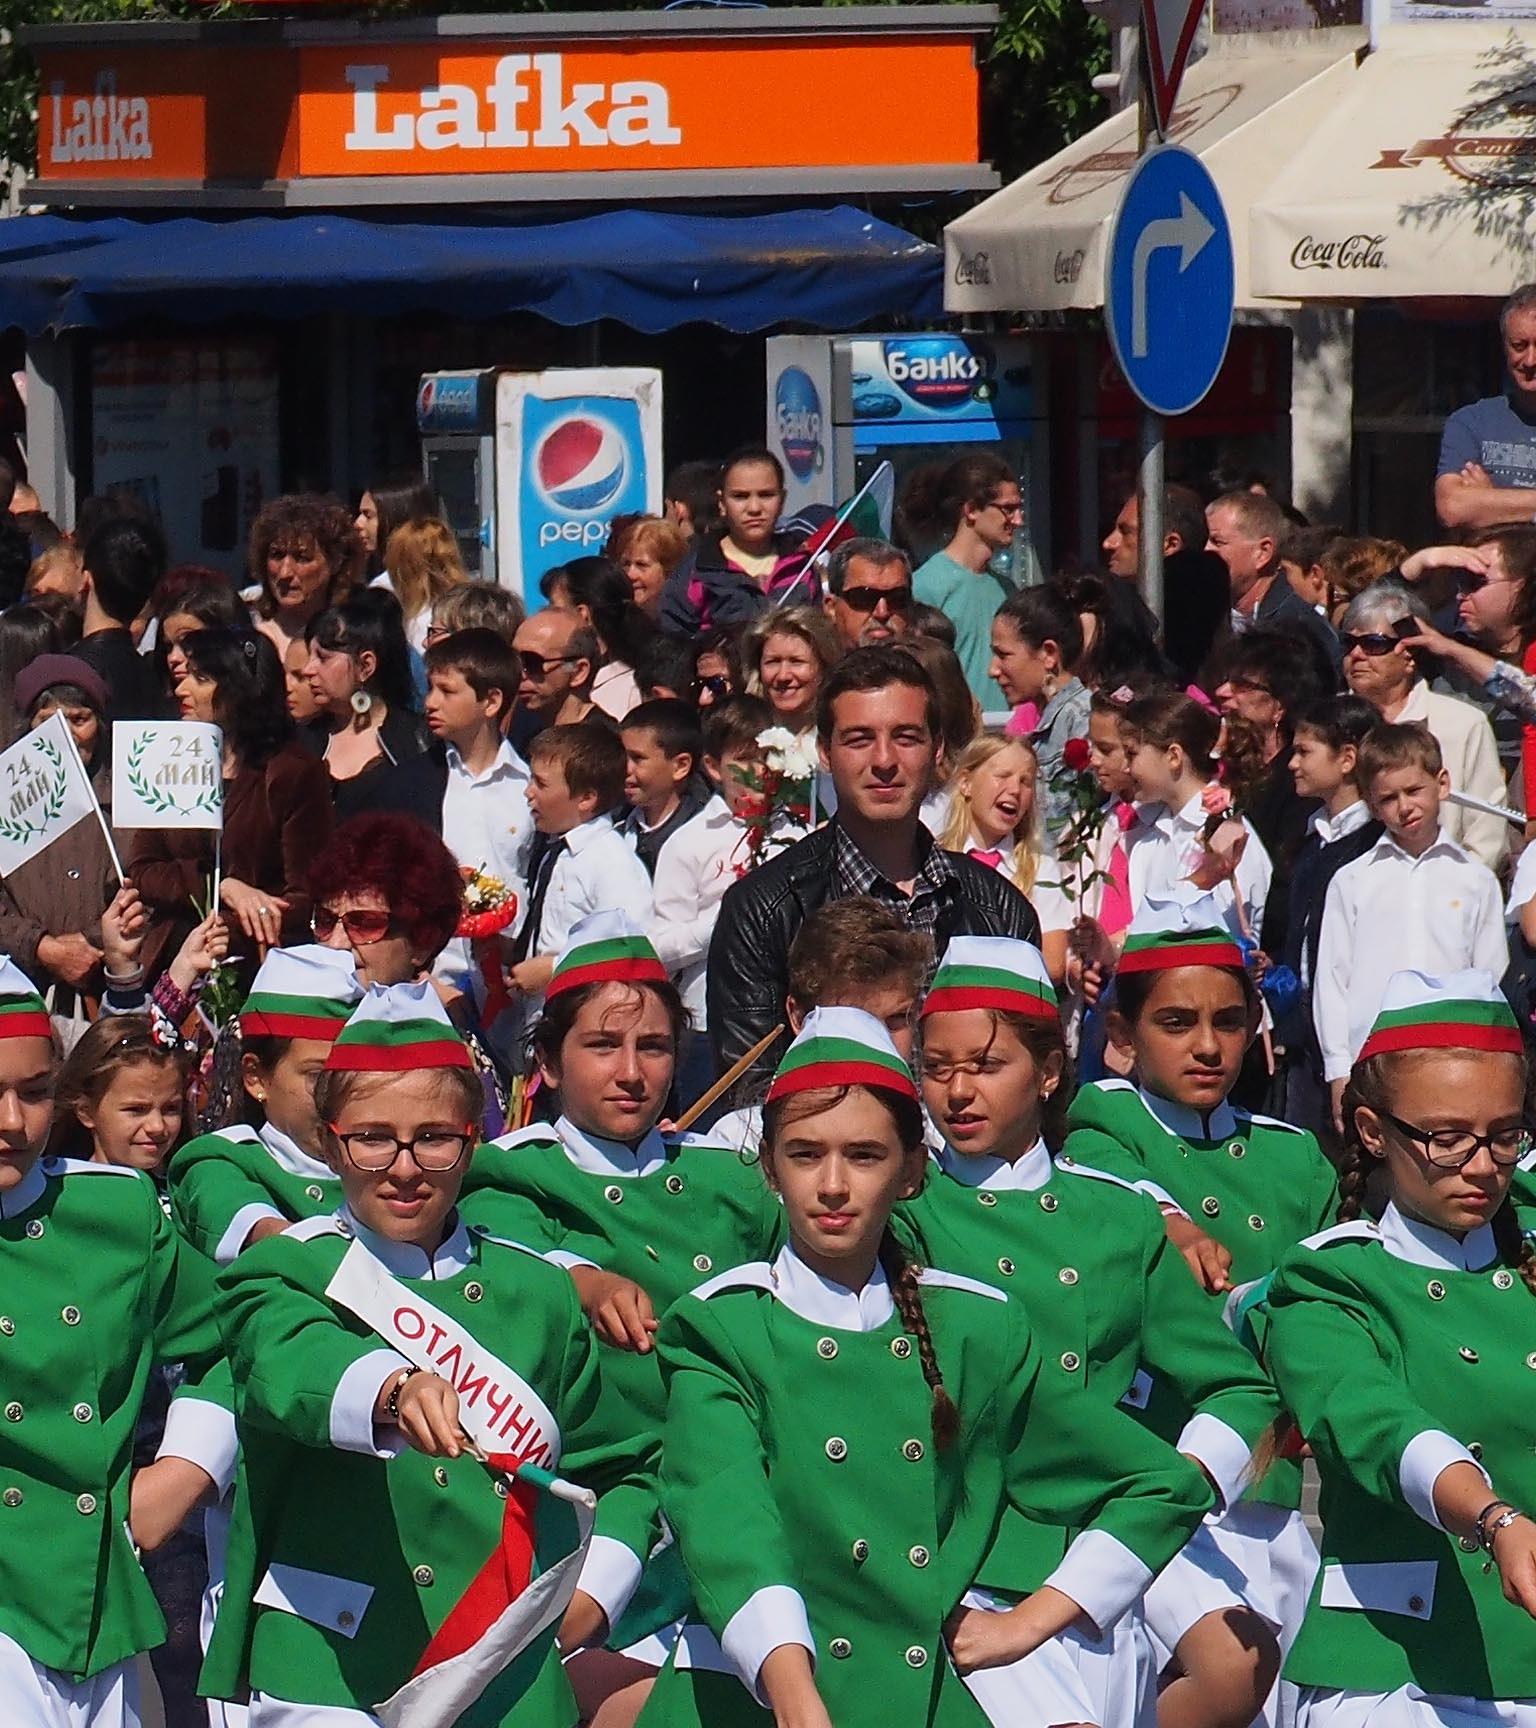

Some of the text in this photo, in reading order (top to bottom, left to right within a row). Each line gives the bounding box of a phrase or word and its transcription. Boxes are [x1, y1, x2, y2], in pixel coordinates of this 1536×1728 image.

[50, 70, 152, 164] Lafka
[343, 52, 682, 152] Lafka
[1289, 234, 1388, 270] Coca-Cola
[169, 735, 203, 757] 24
[6, 753, 31, 787] 24
[154, 759, 215, 786] МАЙ
[9, 767, 50, 819] МАЙ
[392, 1305, 553, 1470] ОТЛИЧНИ
